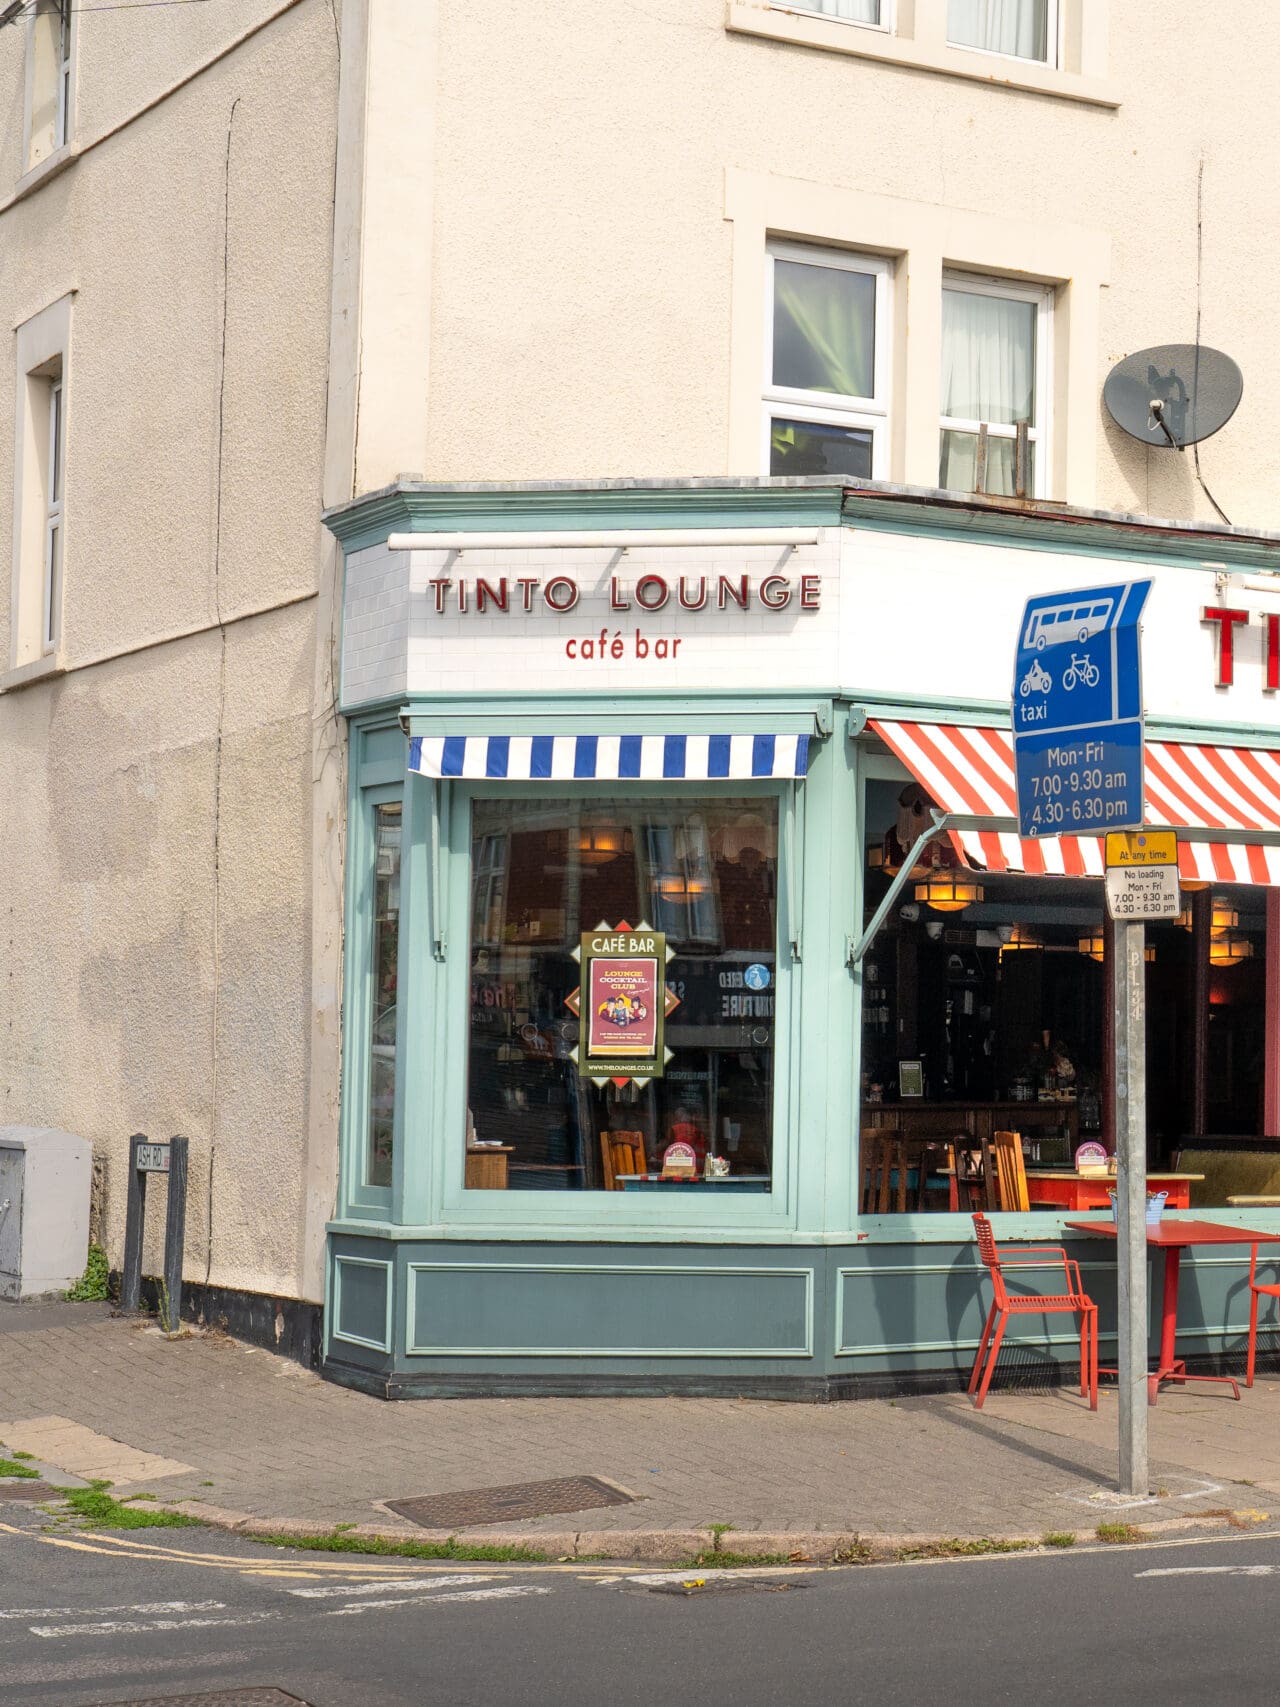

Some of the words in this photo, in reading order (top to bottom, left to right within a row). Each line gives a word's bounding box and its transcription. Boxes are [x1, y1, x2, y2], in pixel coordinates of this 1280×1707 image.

[429, 576, 579, 612] TINTO
[611, 574, 822, 612] LOUNGE
[566, 629, 624, 660] café
[635, 629, 682, 660] bar
[1020, 700, 1047, 722] taxi
[1104, 771, 1127, 788] am
[1106, 800, 1128, 820] pm
[1120, 851, 1129, 860] At
[1132, 852, 1146, 861] any
[1150, 850, 1167, 859] time
[1124, 870, 1136, 879] No
[1138, 869, 1164, 880] loading
[1128, 883, 1144, 892] Mon
[1152, 882, 1162, 890] Fri
[1114, 894, 1134, 903] 7.00
[1143, 893, 1160, 902] 9.30
[1114, 904, 1134, 913] 4.30
[1144, 904, 1160, 912] 6.30
[1164, 904, 1176, 912] pm
[592, 934, 626, 952] CAFÉ
[630, 938, 655, 952] BAR
[138, 1146, 150, 1166] ASH
[152, 1147, 162, 1166] RD
